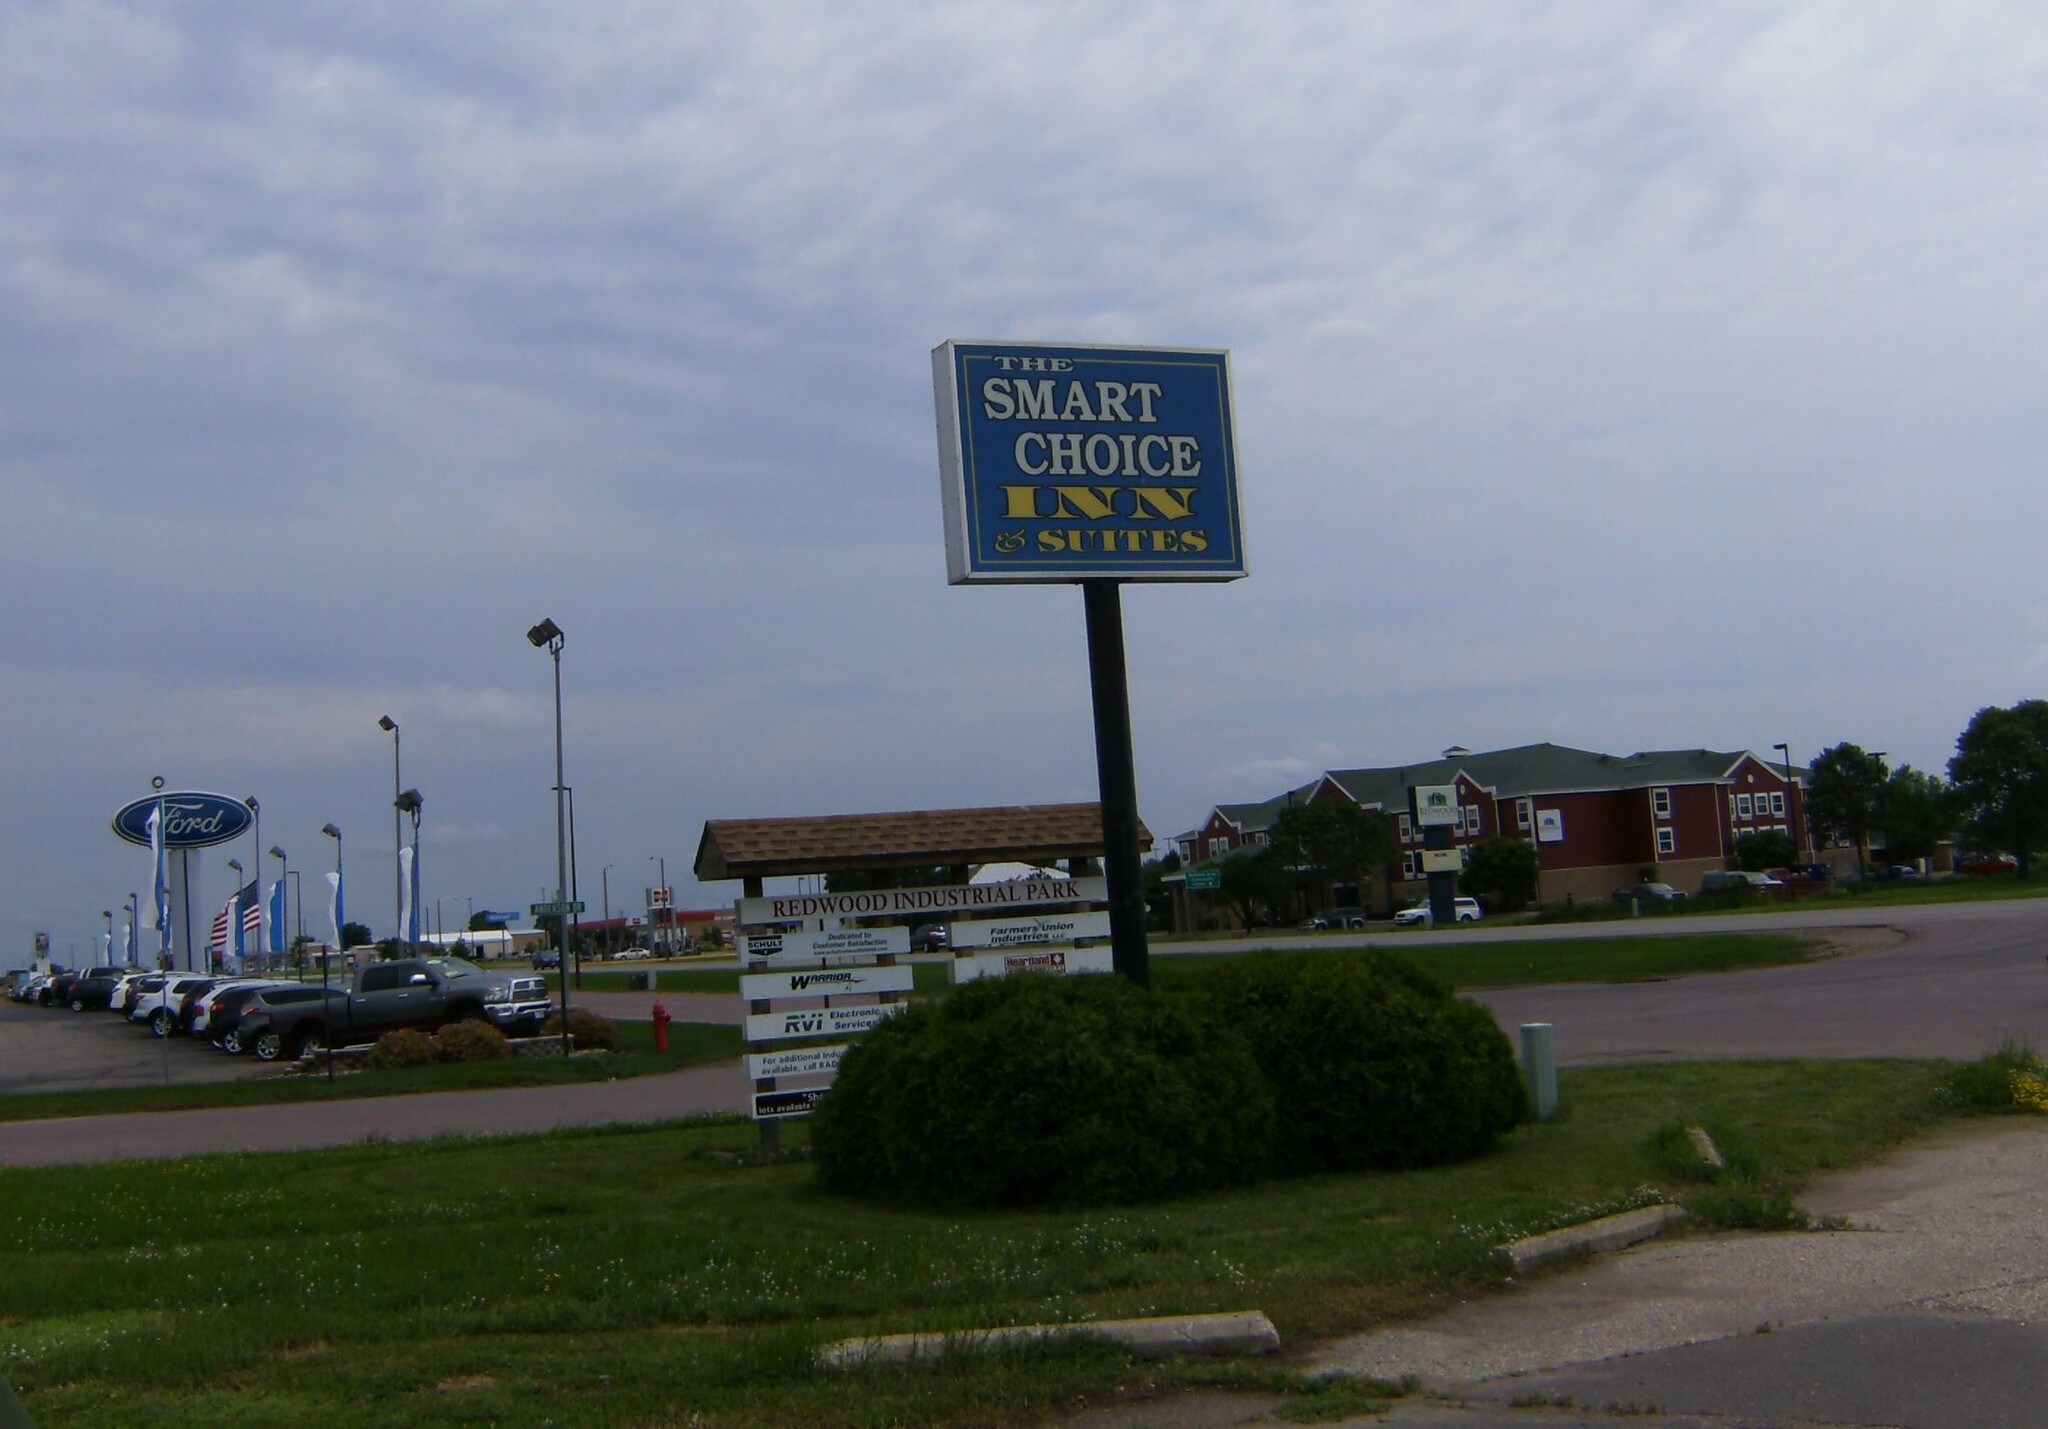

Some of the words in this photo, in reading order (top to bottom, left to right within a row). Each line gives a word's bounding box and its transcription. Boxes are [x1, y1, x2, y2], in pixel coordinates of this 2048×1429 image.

[994, 356, 1074, 372] THE
[983, 377, 1162, 423] SMART
[1015, 432, 1201, 477] CHOICE
[999, 485, 1199, 520] INN
[995, 530, 1026, 552] &
[1037, 529, 1208, 552] SUITES
[145, 802, 224, 834] Ford
[773, 894, 888, 918] REDWOOD
[894, 885, 1021, 910] INDUSTRIAL
[1027, 881, 1080, 901] PARK
[991, 925, 1038, 935] Farmers
[1042, 922, 1074, 931] Union
[828, 932, 863, 941] Dedicated
[991, 931, 1049, 943] Industries
[748, 940, 783, 949] SCHULT
[812, 940, 846, 949] Customer
[847, 939, 888, 948] Satisfaction
[1006, 954, 1050, 967] Heartland
[791, 973, 852, 990] WARRIOR
[830, 1007, 880, 1019] Electronic
[762, 1057, 776, 1065] For
[779, 1052, 820, 1063] additional
[803, 1062, 817, 1070] call
[758, 1106, 774, 1115] lots
[776, 1102, 811, 1113] available
